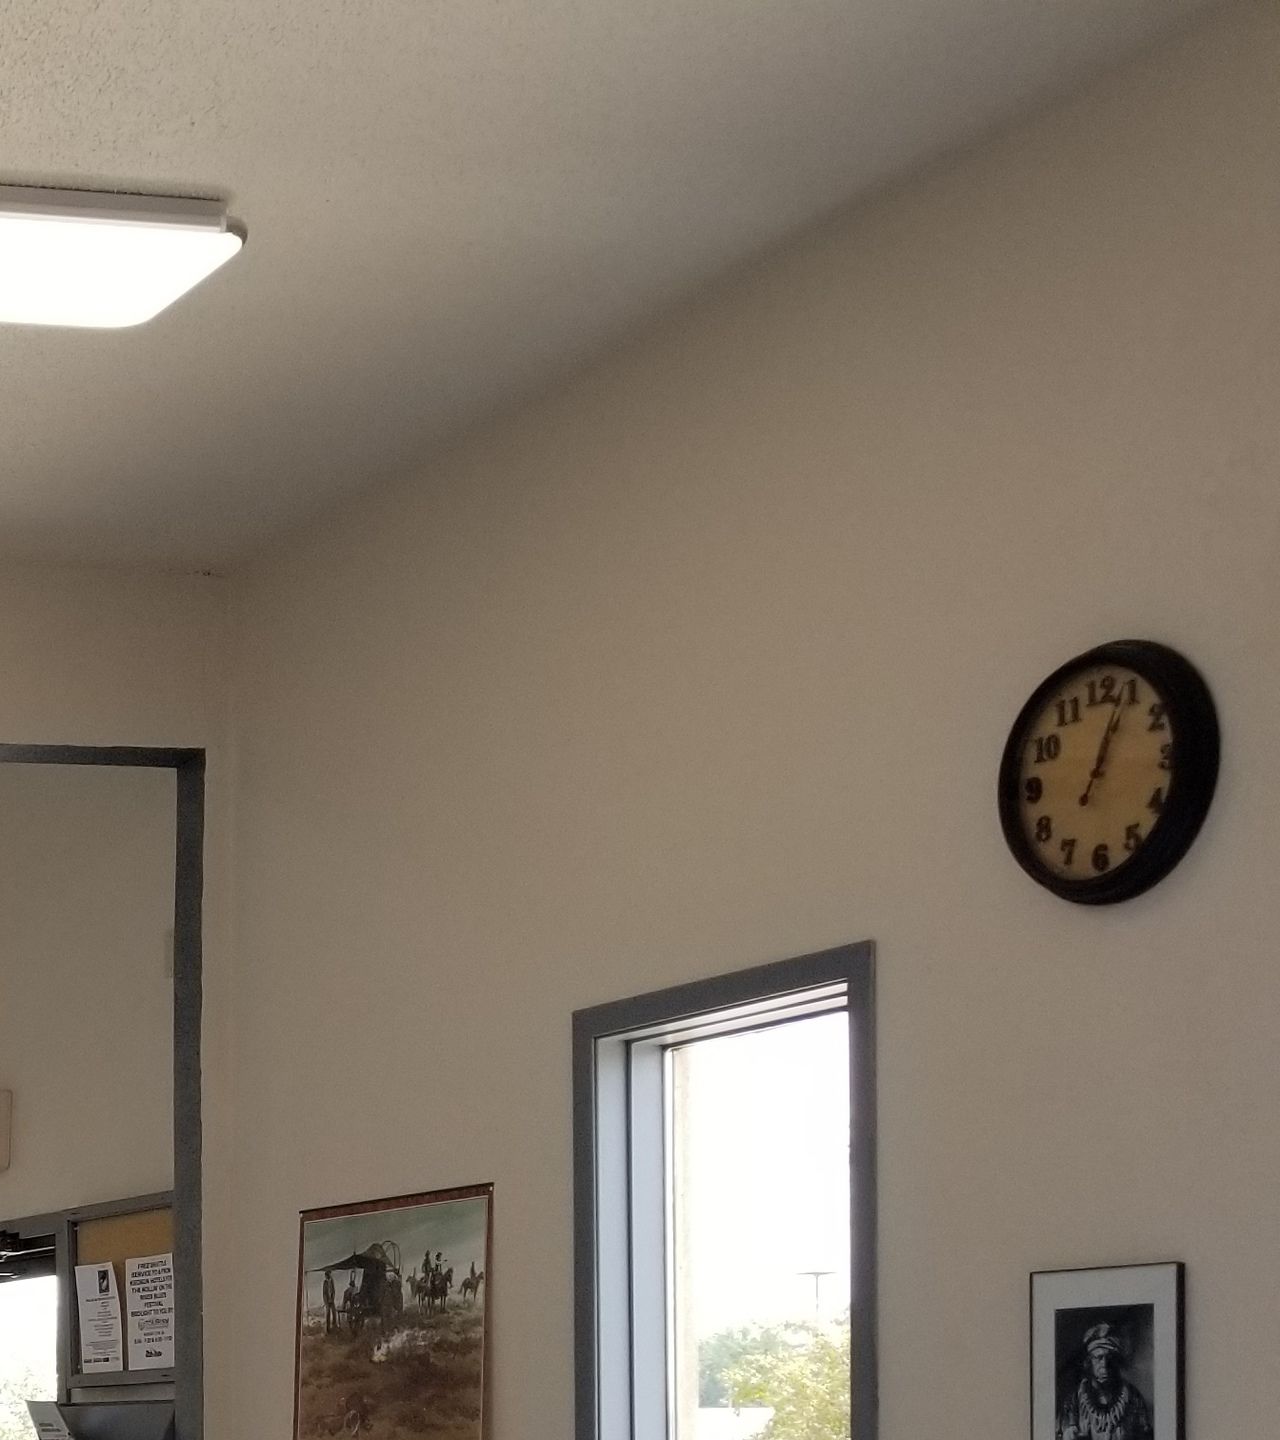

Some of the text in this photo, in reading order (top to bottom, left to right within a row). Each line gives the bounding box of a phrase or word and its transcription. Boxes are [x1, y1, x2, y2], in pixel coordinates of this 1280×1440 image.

[1086, 676, 1121, 707] 12
[1125, 680, 1139, 705] 1
[1056, 697, 1081, 727] 11
[1148, 704, 1166, 731] 2
[1034, 734, 1060, 763] 10
[1024, 777, 1043, 803] 9
[1146, 788, 1165, 815] 4
[1035, 816, 1052, 843] 8
[1125, 823, 1143, 852] 5
[1060, 839, 1078, 866] 7
[1091, 844, 1111, 871] 6
